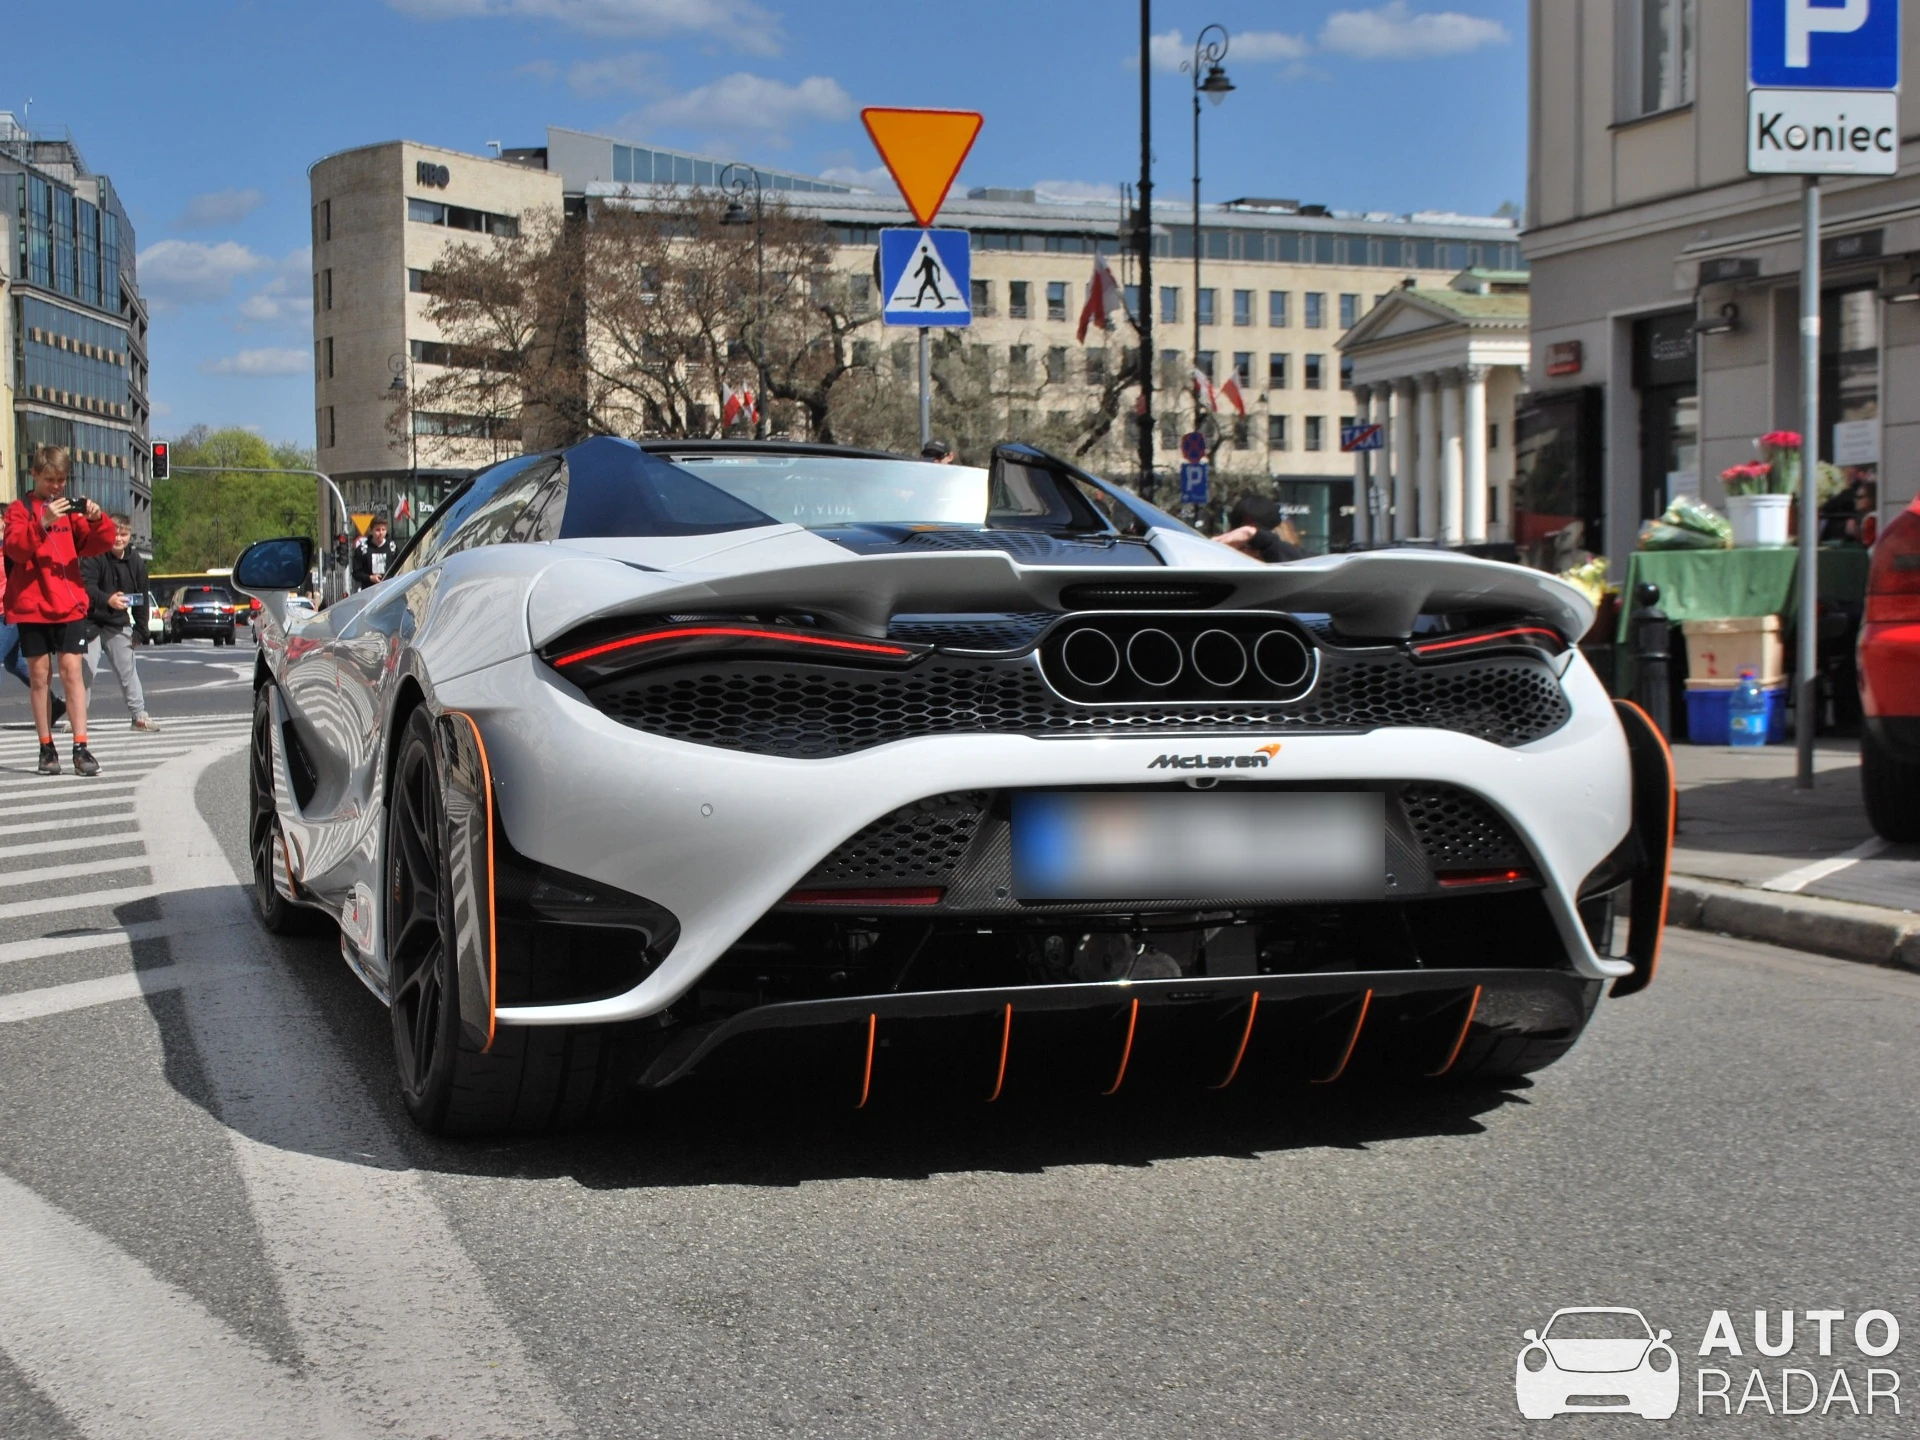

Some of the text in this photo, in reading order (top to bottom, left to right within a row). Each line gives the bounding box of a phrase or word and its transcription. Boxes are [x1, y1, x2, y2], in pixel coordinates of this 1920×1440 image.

[1784, 0, 1869, 68] P
[1757, 112, 1893, 152] Koniec
[416, 161, 450, 190] HBO
[1342, 428, 1383, 448] TAXI
[1186, 466, 1203, 491] P
[1147, 754, 1268, 769] McLaren
